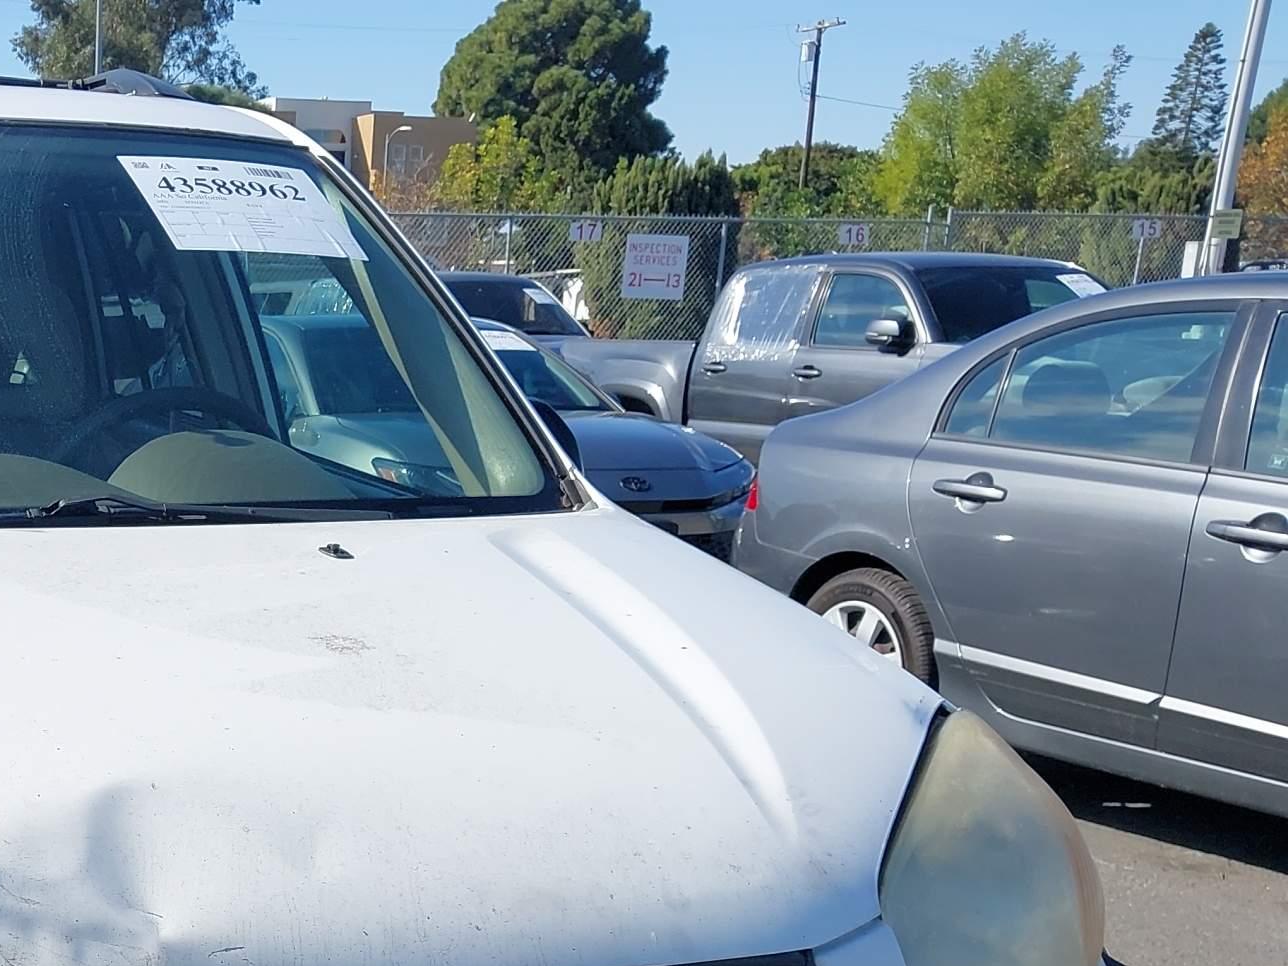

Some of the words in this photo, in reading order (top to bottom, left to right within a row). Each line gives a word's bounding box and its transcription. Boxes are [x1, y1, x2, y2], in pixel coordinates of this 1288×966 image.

[158, 176, 306, 201] 43588962
[576, 223, 597, 241] 17
[845, 227, 865, 244] 16
[1138, 222, 1157, 237] 15
[629, 243, 682, 255] INSPECTION
[632, 255, 678, 266] SERVICES
